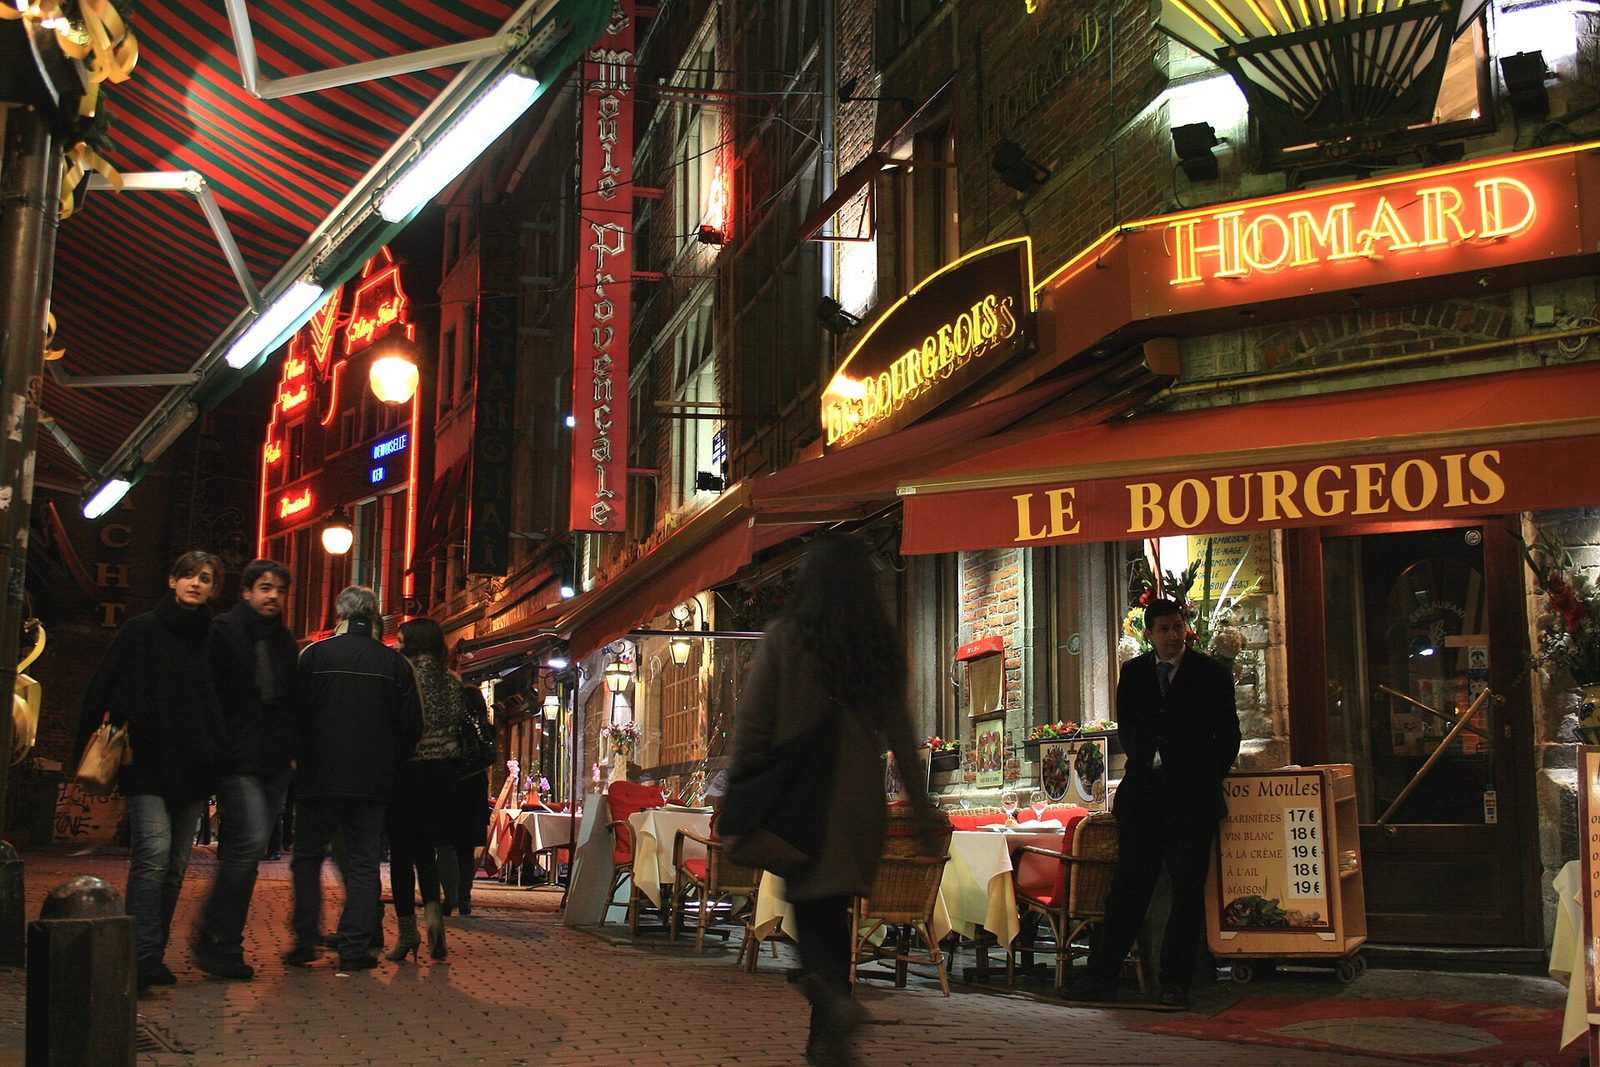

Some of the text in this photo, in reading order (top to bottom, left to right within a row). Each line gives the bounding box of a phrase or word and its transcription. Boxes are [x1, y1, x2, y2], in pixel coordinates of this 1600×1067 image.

[588, 49, 635, 201] Moule
[1168, 176, 1538, 286] HOMARD
[588, 221, 626, 525] Provençale
[860, 294, 999, 422] BOURGEOIS
[1012, 448, 1506, 542] LE BOURGEOIS
[1222, 777, 1319, 798] Nos Moules
[1224, 831, 1241, 840] VIN
[1244, 831, 1274, 840] BLANC
[1236, 850, 1247, 858] LA
[1250, 847, 1283, 858] CRÈME
[1227, 884, 1265, 895] MAISON
